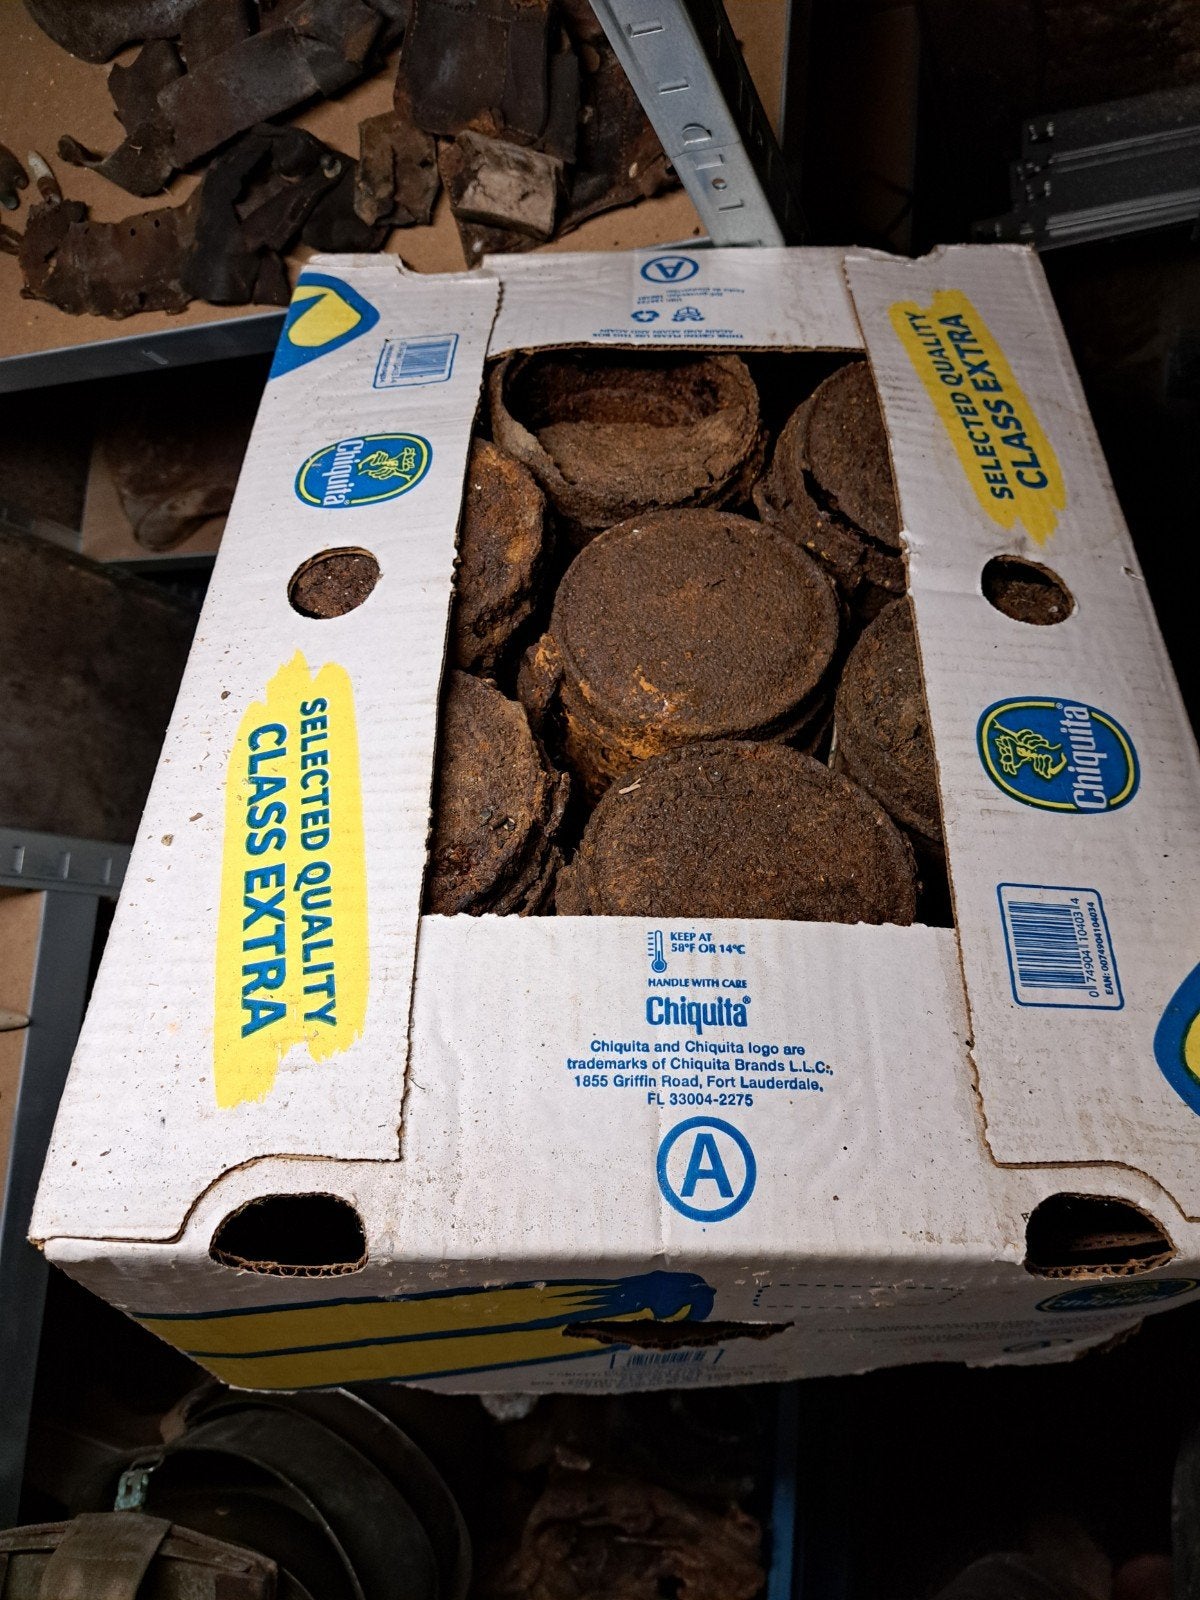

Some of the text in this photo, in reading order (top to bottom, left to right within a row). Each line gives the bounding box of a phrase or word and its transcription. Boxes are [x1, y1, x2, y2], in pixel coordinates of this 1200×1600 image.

[904, 311, 1014, 500] SELECTED QUALITY
[938, 314, 1048, 490] CLASS EXTRA
[294, 697, 337, 1027] SELECTED QUALITY
[240, 722, 288, 1039] CLASS EXTRA
[670, 932, 712, 942] KEEP AT
[1073, 911, 1088, 942] 10403
[698, 944, 716, 954] OR
[1082, 950, 1097, 982] 74904
[648, 978, 747, 988] HANDLE WITH CARE
[1102, 973, 1114, 996] EAN:
[590, 1040, 806, 1057] Chiquita and Chiquita logo are
[566, 1058, 648, 1070] trademarks
[652, 1058, 666, 1070] of
[670, 1058, 730, 1073] Chiquita
[734, 1059, 785, 1072] Brands
[574, 1075, 608, 1088] 1855
[613, 1075, 656, 1088] Griffin
[662, 1076, 703, 1090] Road,
[706, 1076, 736, 1088] Fort
[648, 1092, 754, 1107] FL 33004-2275
[680, 1132, 735, 1198] A
